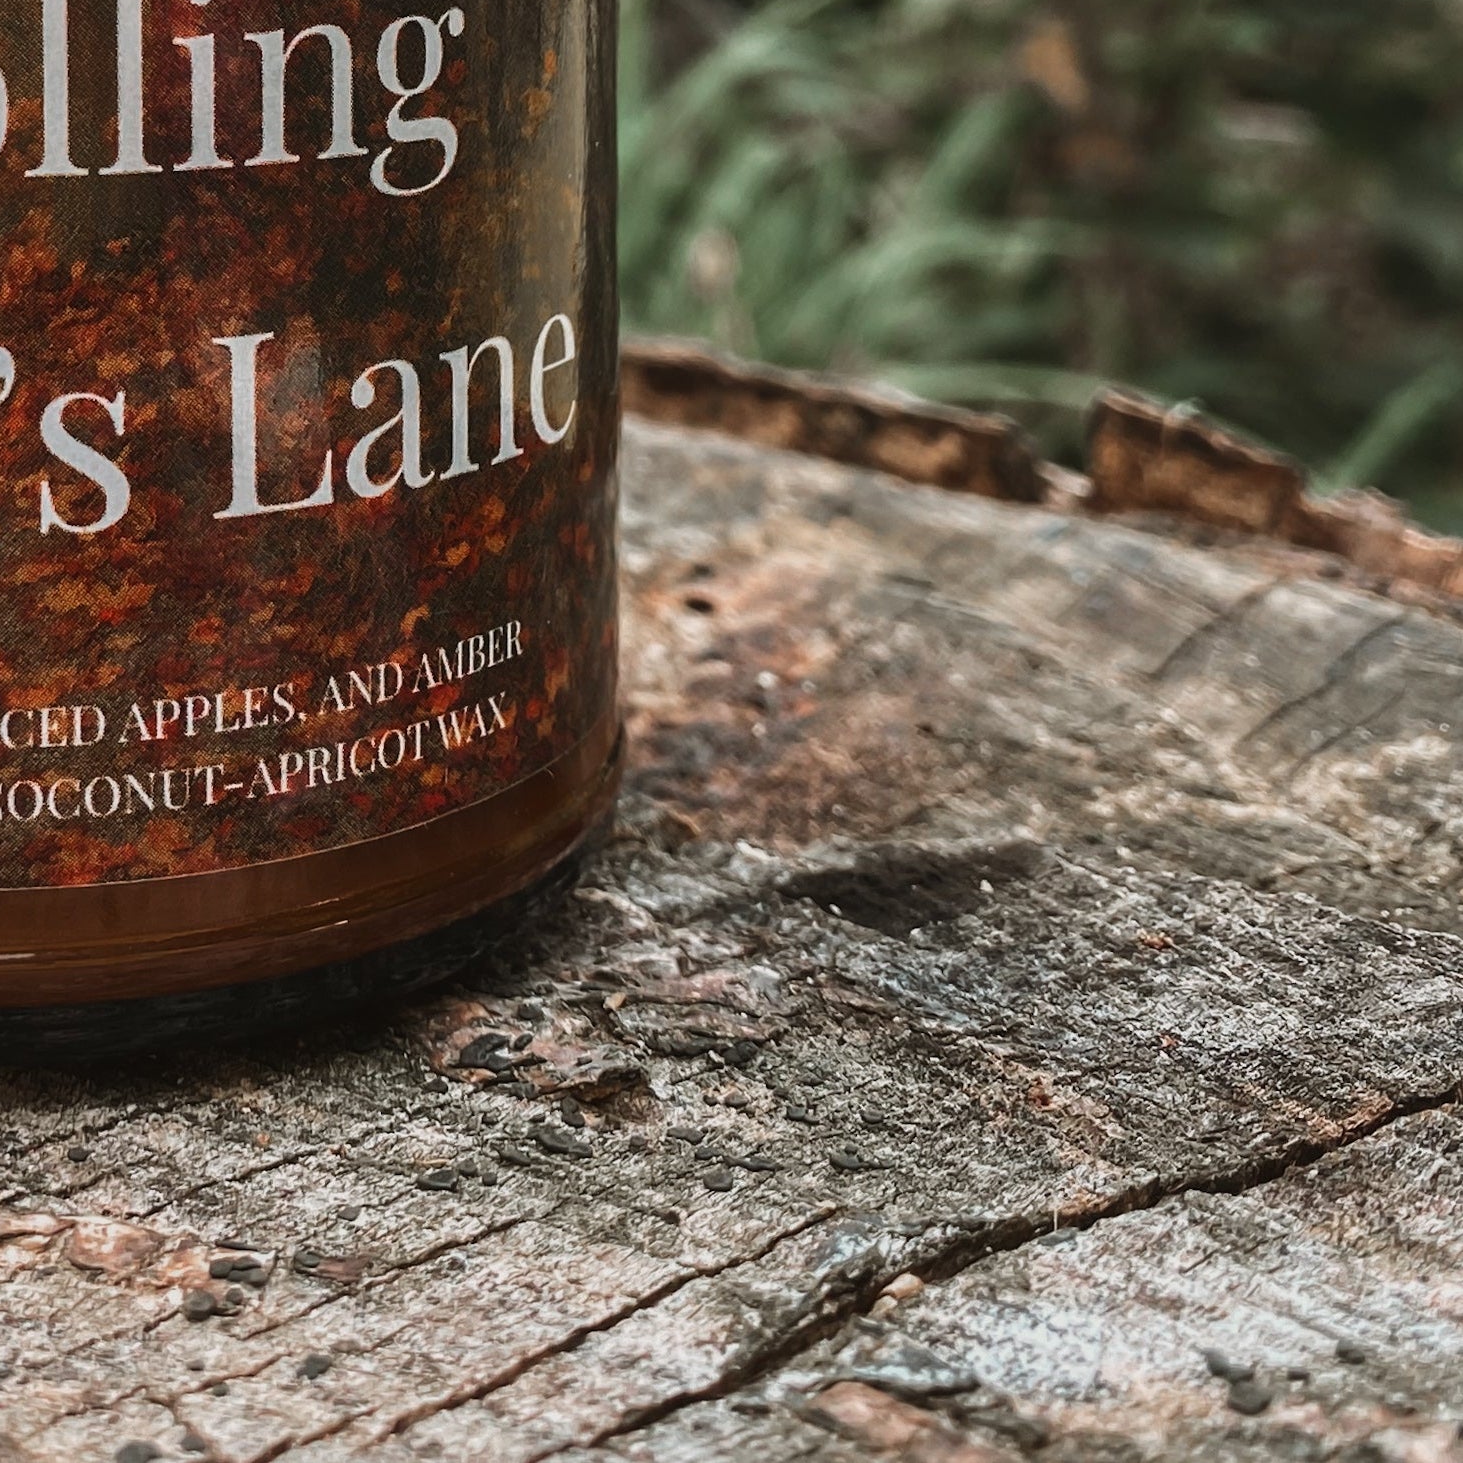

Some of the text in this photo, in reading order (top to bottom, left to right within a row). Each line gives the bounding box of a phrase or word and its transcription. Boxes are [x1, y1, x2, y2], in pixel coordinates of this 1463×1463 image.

[211, 312, 578, 522] Lane
[318, 660, 404, 718] AND
[411, 619, 525, 695] AMBER
[434, 691, 508, 750] WAX
